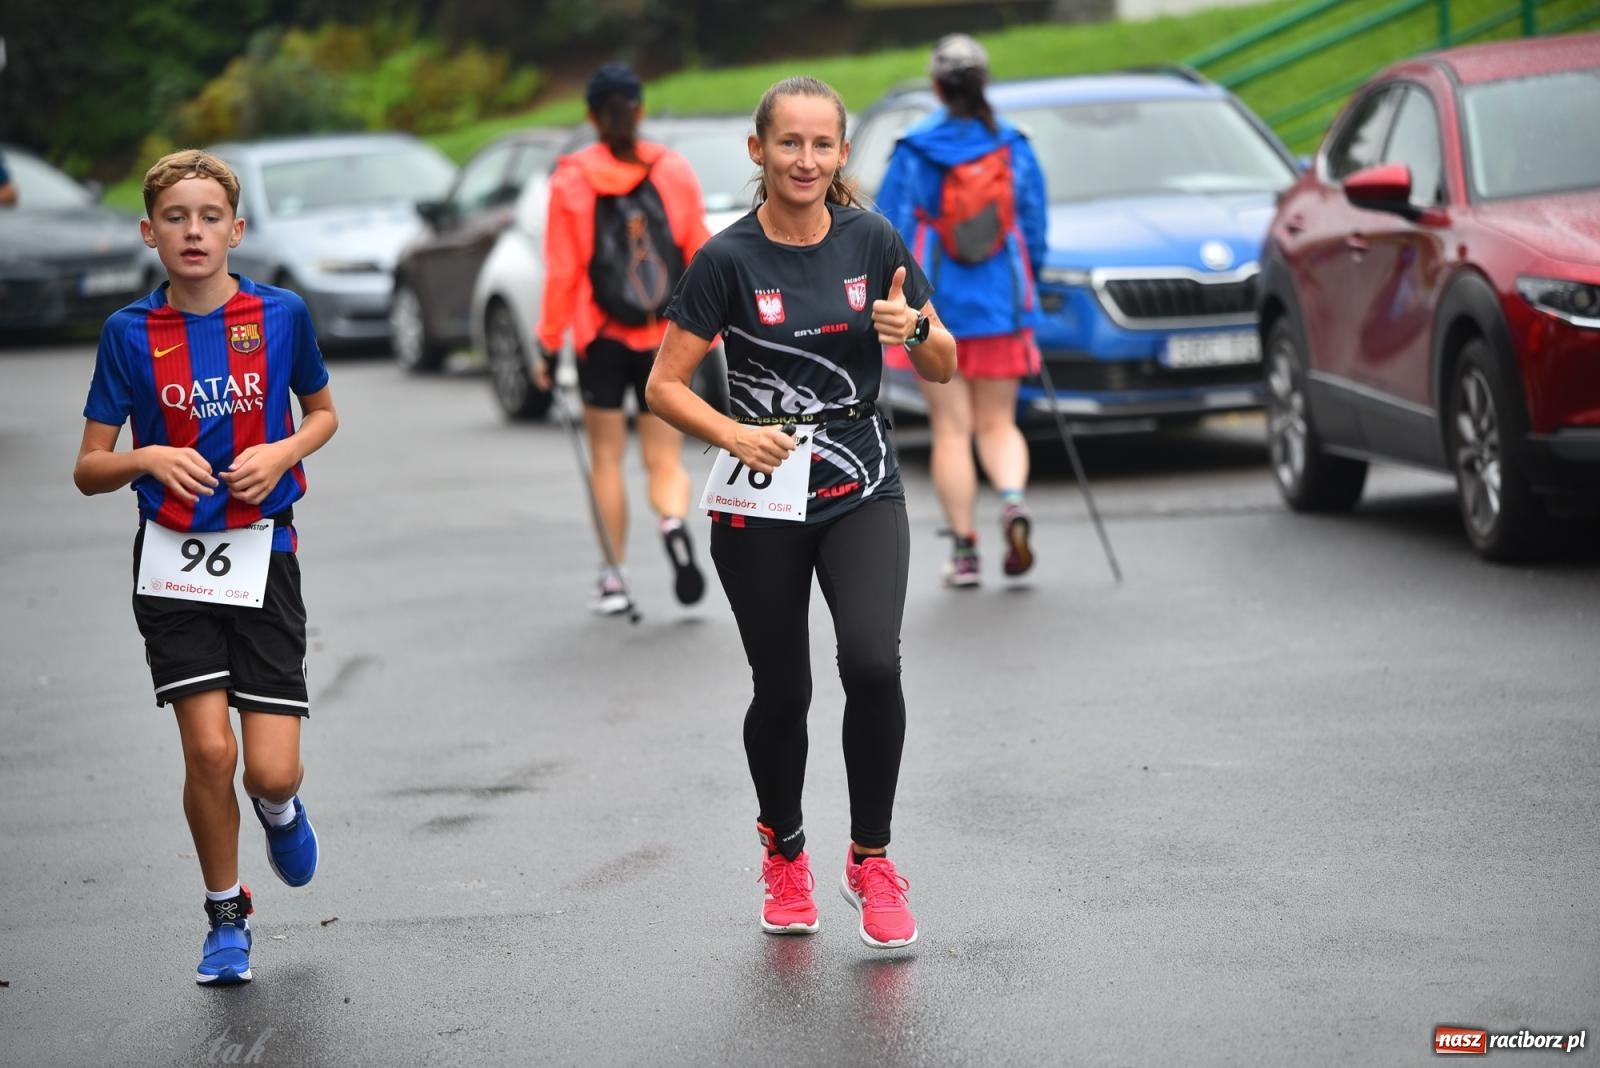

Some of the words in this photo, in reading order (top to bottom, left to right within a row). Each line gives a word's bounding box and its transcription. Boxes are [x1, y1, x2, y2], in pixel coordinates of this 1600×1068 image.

[161, 372, 263, 411] QATAR
[189, 397, 264, 421] AIRWAYS
[715, 495, 757, 510] Racibórz
[768, 502, 792, 513] OSiR
[180, 538, 232, 577] 96
[165, 581, 214, 596] Racibórz
[225, 589, 250, 600] OSiR
